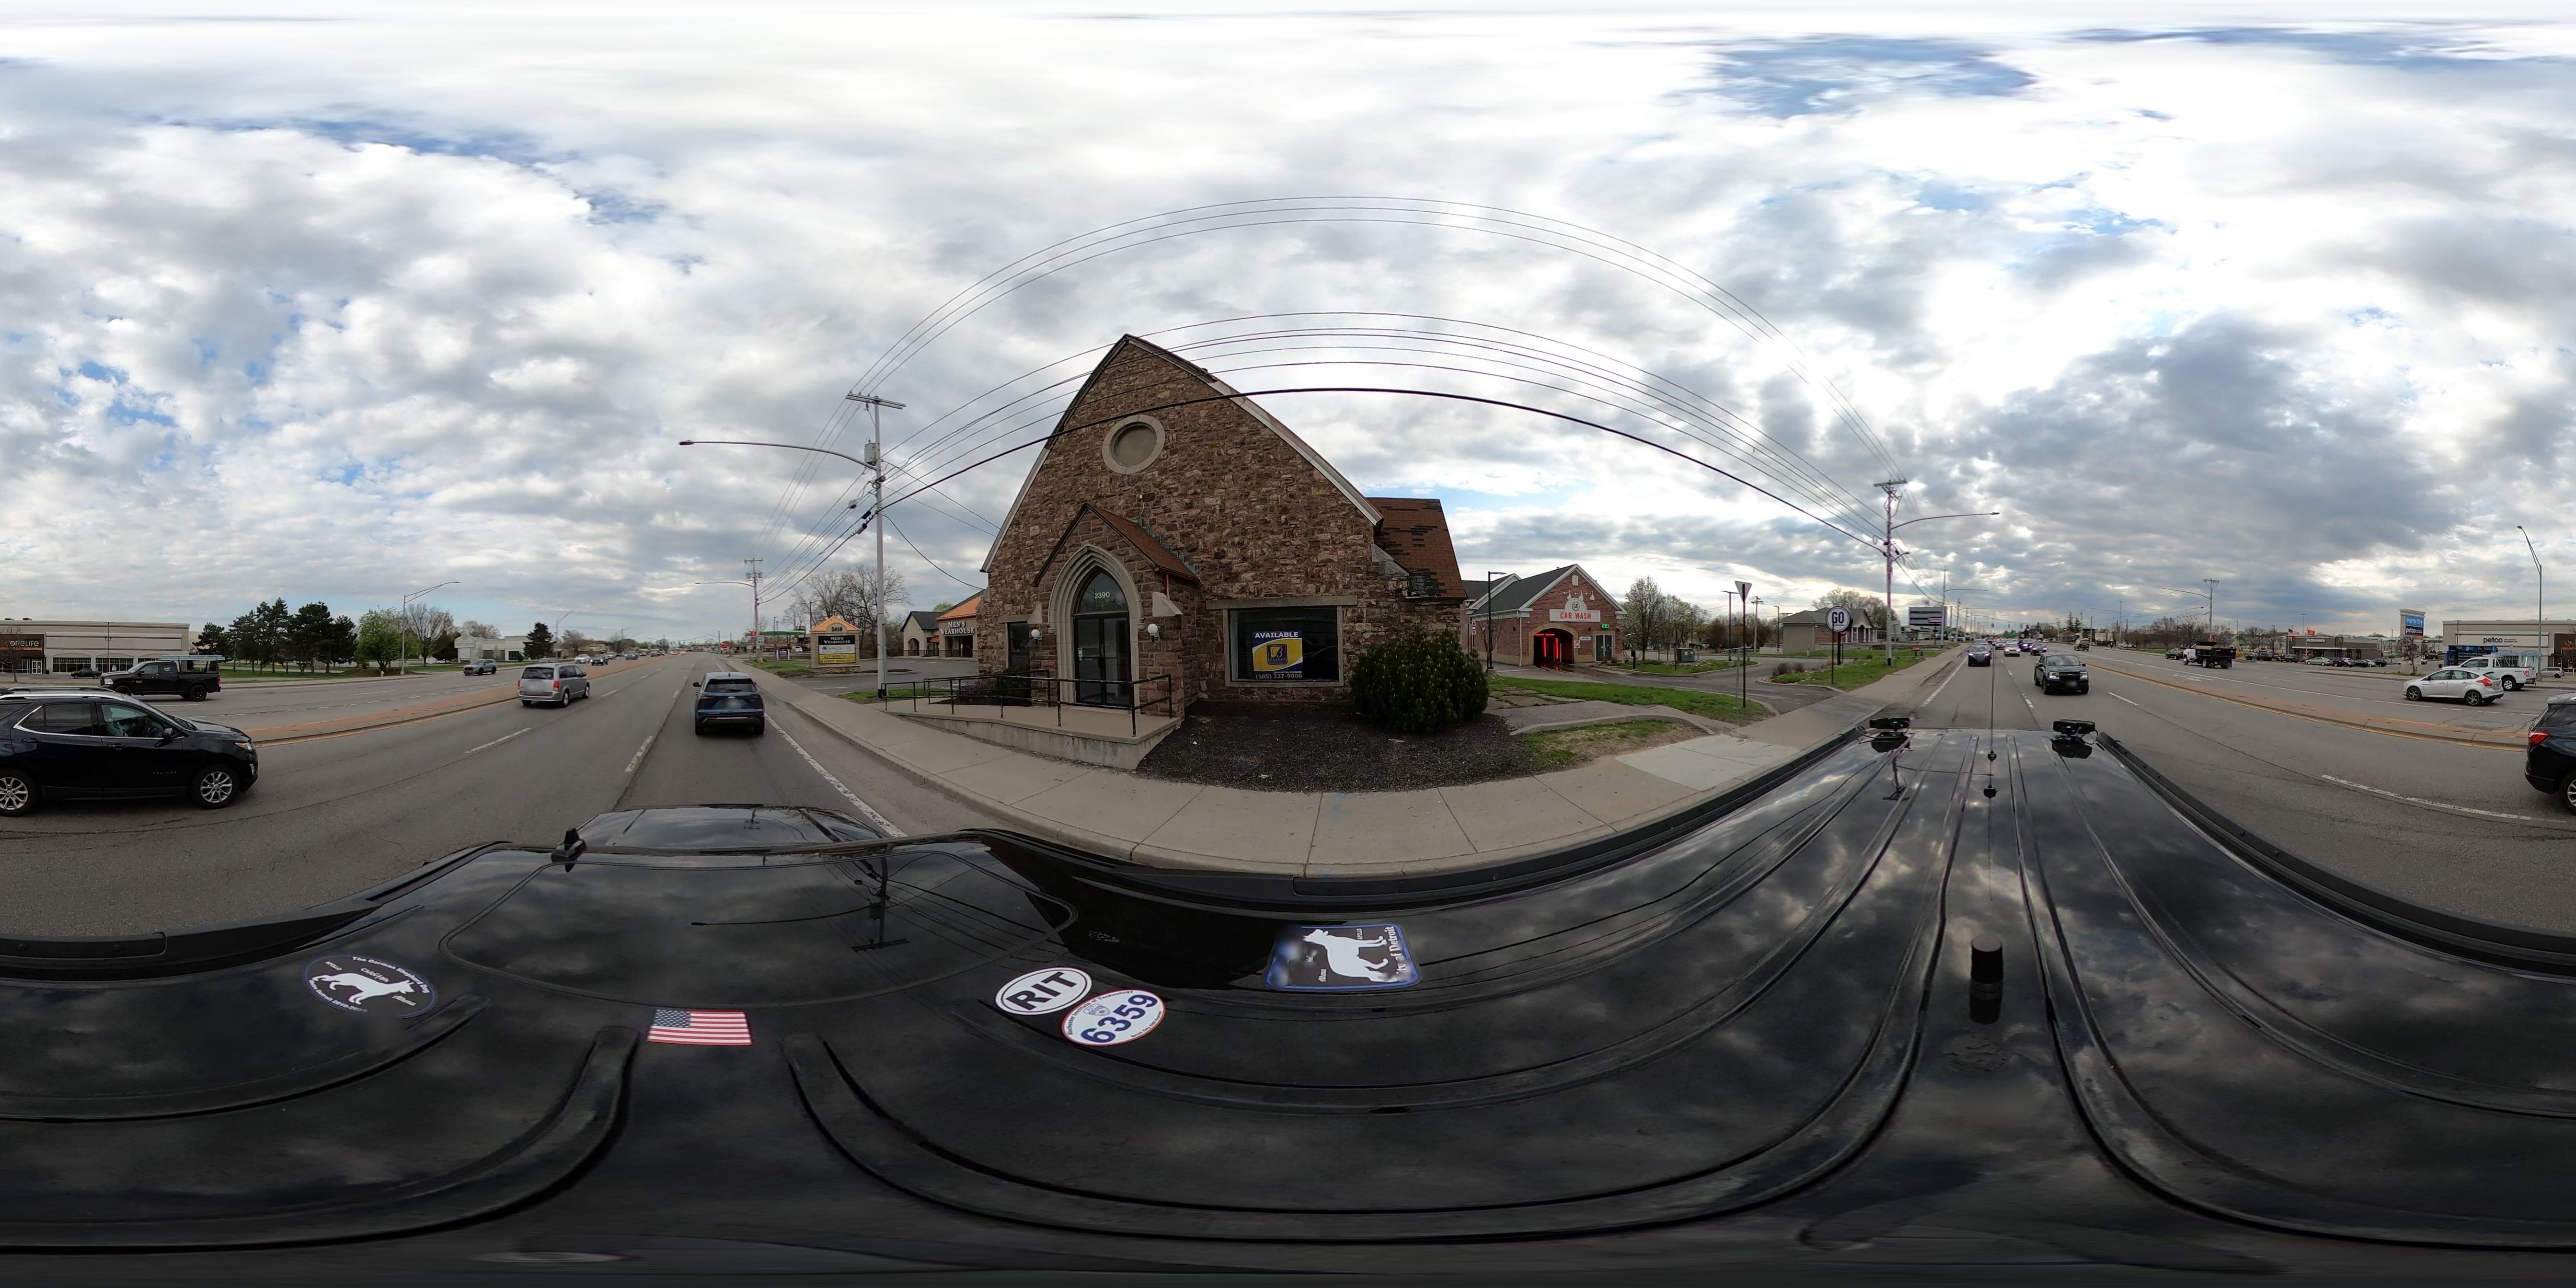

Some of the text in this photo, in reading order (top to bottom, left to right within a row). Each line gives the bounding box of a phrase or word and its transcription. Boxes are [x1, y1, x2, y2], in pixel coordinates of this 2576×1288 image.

[1832, 611, 1844, 623] GO
[1384, 926, 1401, 952] Detroit
[325, 961, 343, 971] APOLLO
[368, 959, 397, 970] German
[396, 967, 424, 985] Shepherd
[419, 983, 431, 994] Dog
[316, 989, 333, 1001] Detroit
[1004, 971, 1078, 1011] RIT
[1073, 1002, 1091, 1017] Institute
[1097, 990, 1134, 1000] Technology
[1081, 995, 1158, 1043] 6359
